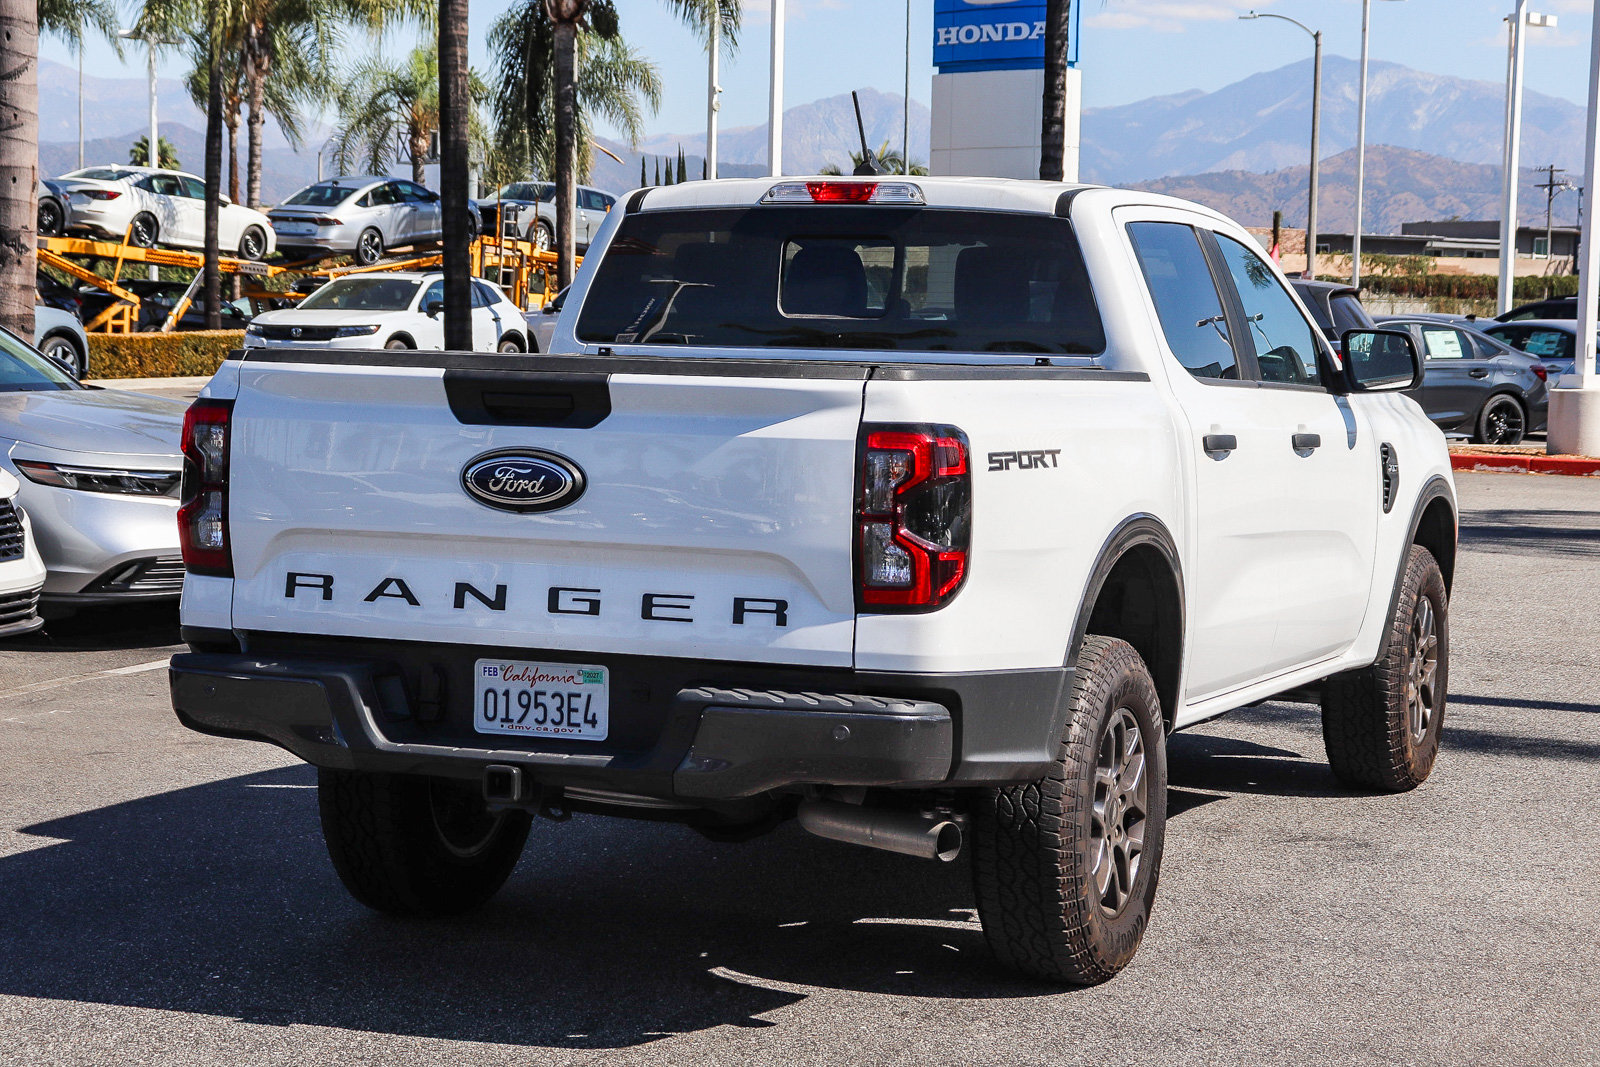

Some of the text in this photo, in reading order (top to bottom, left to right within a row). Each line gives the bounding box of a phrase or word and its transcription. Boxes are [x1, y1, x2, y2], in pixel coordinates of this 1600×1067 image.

[937, 21, 1045, 46] HONDA
[987, 449, 1062, 472] SPORT
[488, 466, 546, 494] Ford
[285, 571, 789, 627] RANGER
[483, 666, 498, 677] FEB
[502, 664, 584, 688] California
[483, 688, 598, 729] 01953E4
